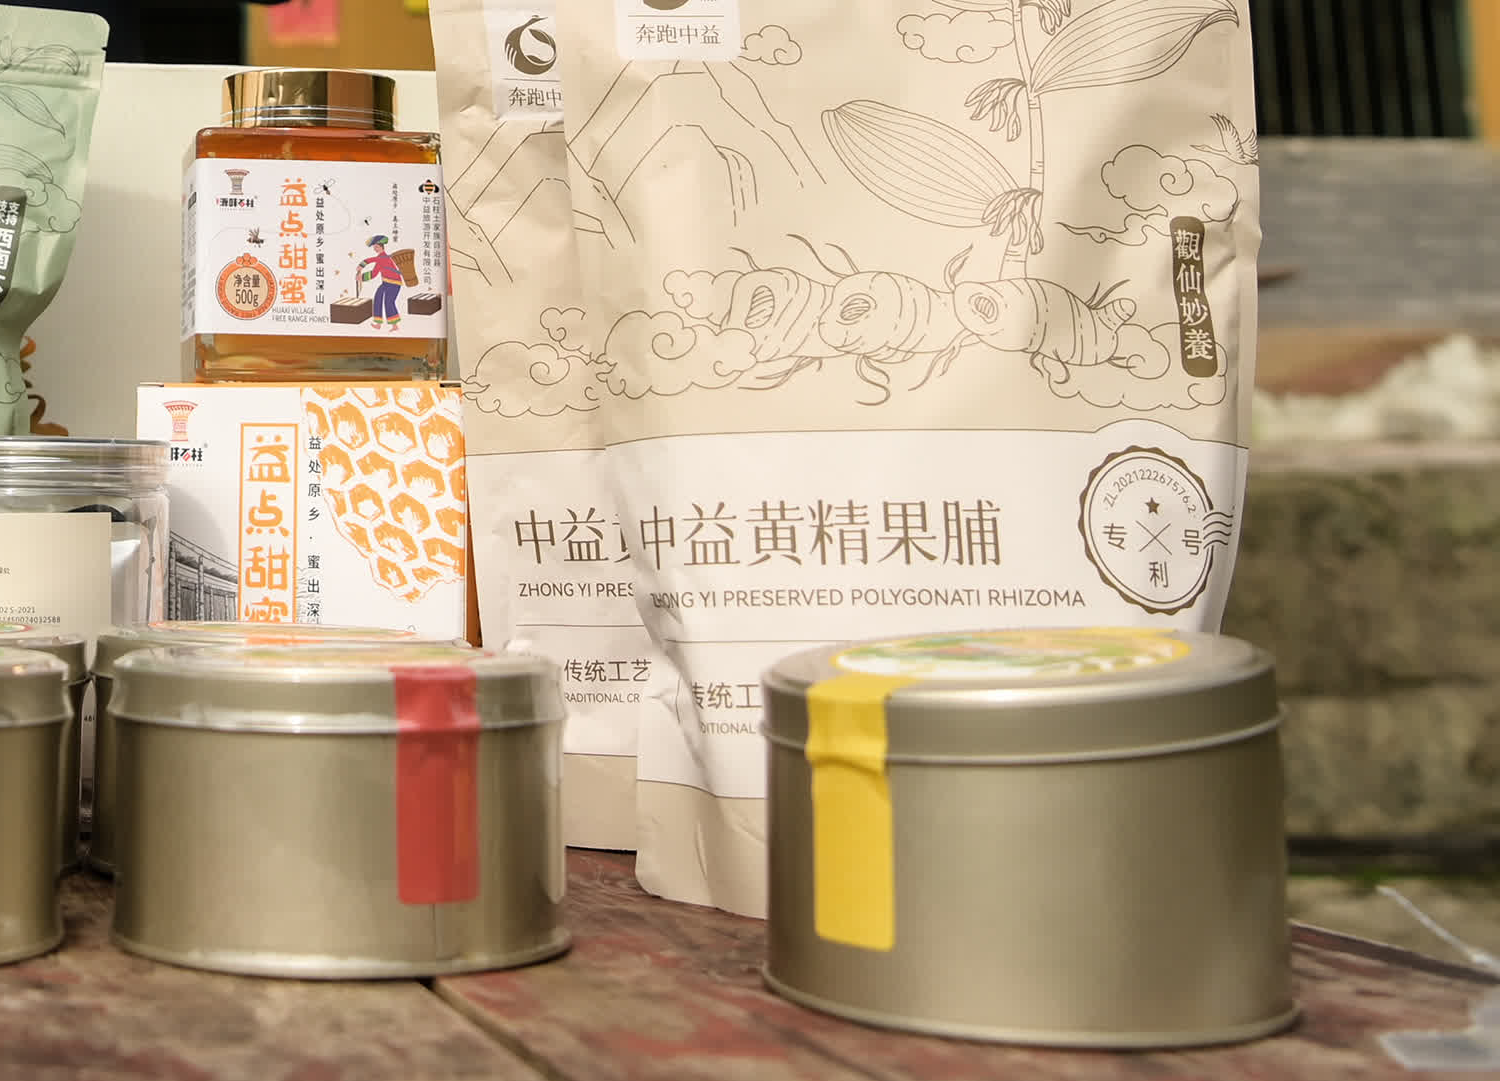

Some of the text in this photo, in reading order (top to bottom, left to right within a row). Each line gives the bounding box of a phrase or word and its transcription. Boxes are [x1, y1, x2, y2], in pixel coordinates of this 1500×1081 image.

[635, 23, 722, 45] 奔跑中益
[508, 86, 562, 108] 奔跑中
[278, 177, 309, 304] 益点甜蜜
[233, 274, 261, 288] 净含量
[235, 289, 259, 307] 500g
[1174, 228, 1214, 361] 觀仙妙養
[288, 315, 308, 323] RANGE
[1103, 487, 1118, 508] ZL
[639, 499, 1001, 570] 中益黄精果脯
[518, 583, 574, 598] ZHONG
[580, 583, 591, 597] YI
[650, 587, 1085, 609] ZHONG YI PRESERVED POLYGONATI RHIZOMA
[564, 659, 652, 682] 传统工艺
